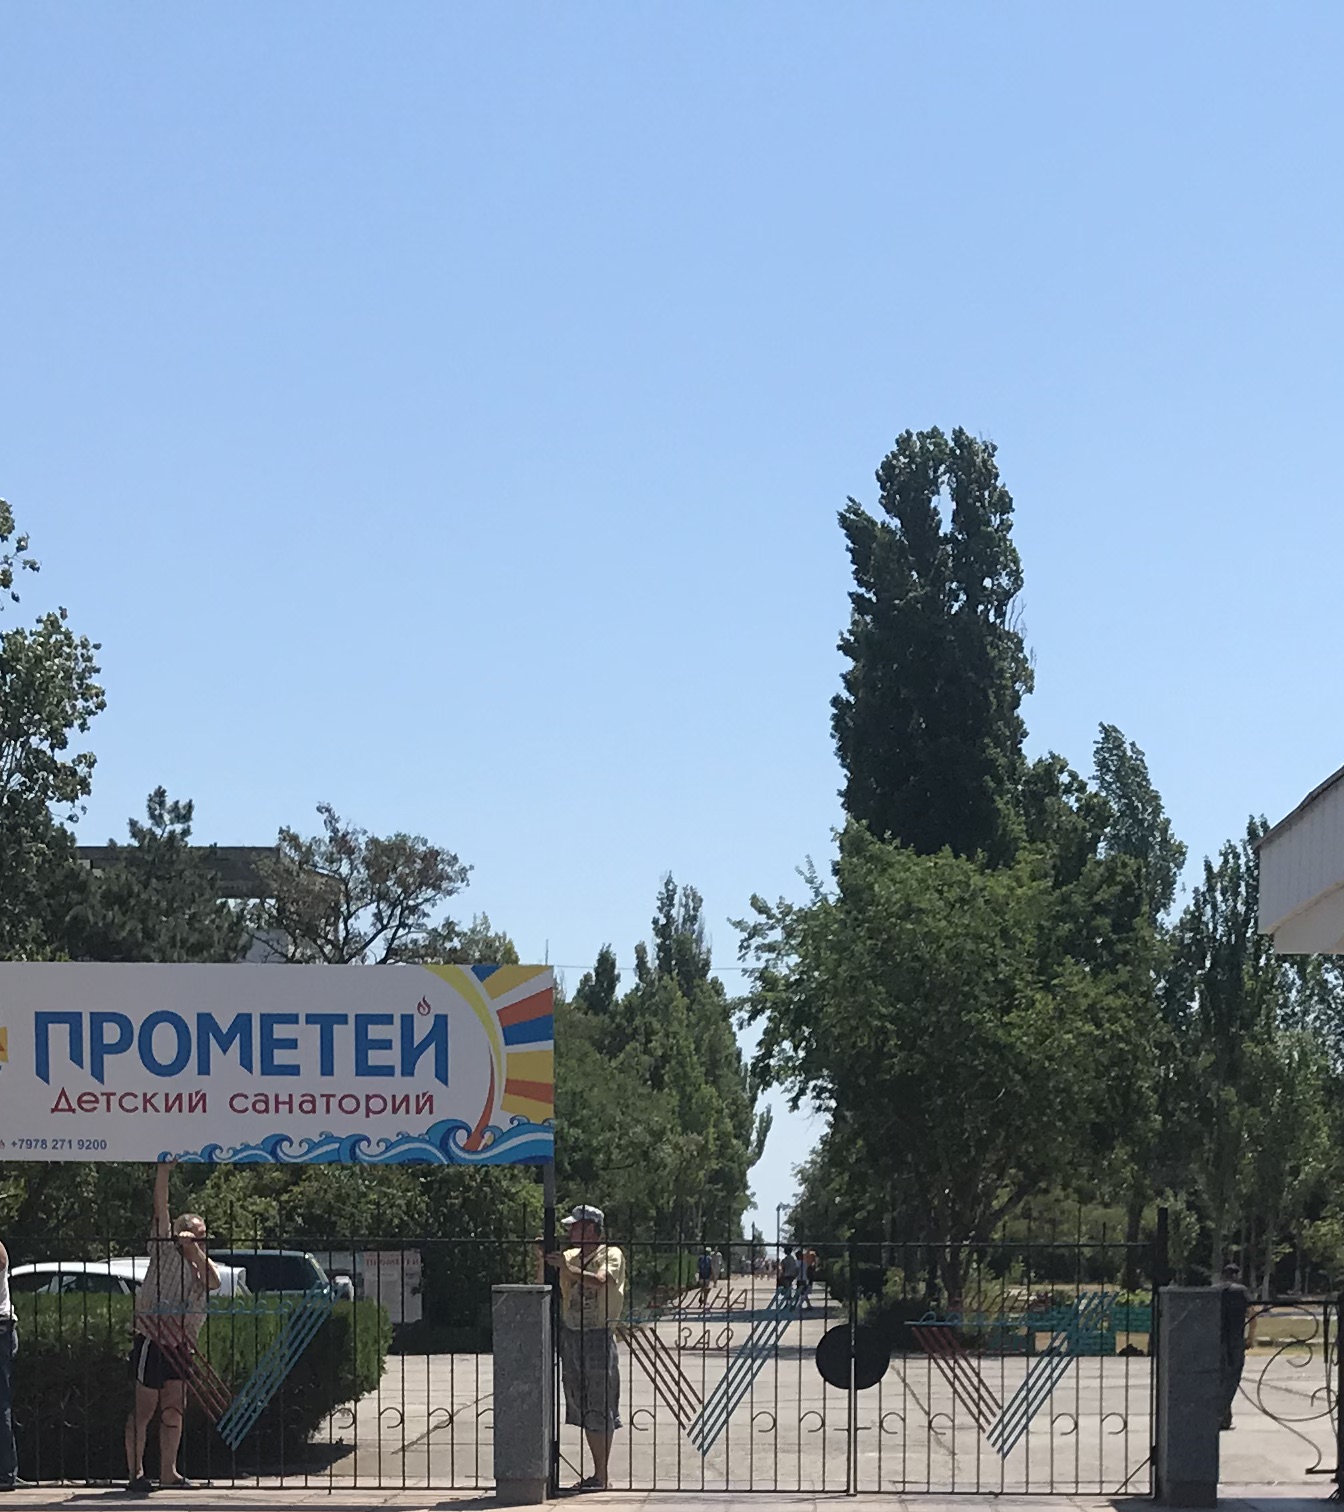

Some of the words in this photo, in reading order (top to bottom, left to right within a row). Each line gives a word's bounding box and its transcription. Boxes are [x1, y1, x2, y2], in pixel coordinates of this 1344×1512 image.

[34, 1000, 449, 1088] ПРОМЕТЕЙ
[51, 1087, 207, 1114] Детский
[228, 1091, 434, 1118] санаторий
[10, 1138, 48, 1150] +7978
[51, 1138, 73, 1150] 271
[77, 1139, 107, 1150] 9200
